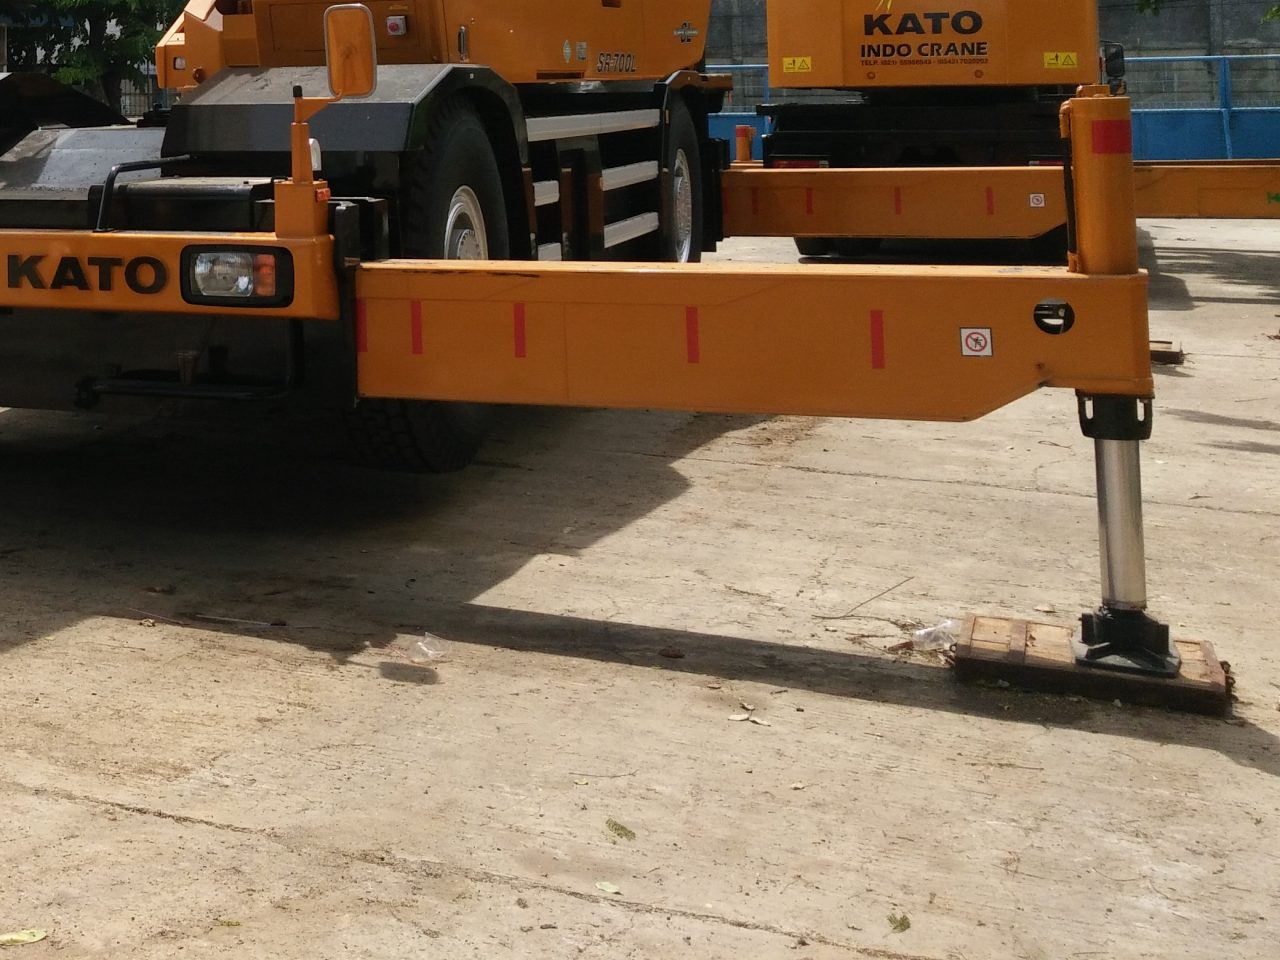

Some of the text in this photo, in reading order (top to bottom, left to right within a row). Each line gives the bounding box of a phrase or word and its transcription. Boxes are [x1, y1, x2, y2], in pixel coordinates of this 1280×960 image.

[864, 10, 983, 36] KATO
[861, 41, 988, 58] INDO CRANE
[597, 52, 637, 73] SR-700L
[7, 254, 168, 295] KATO
